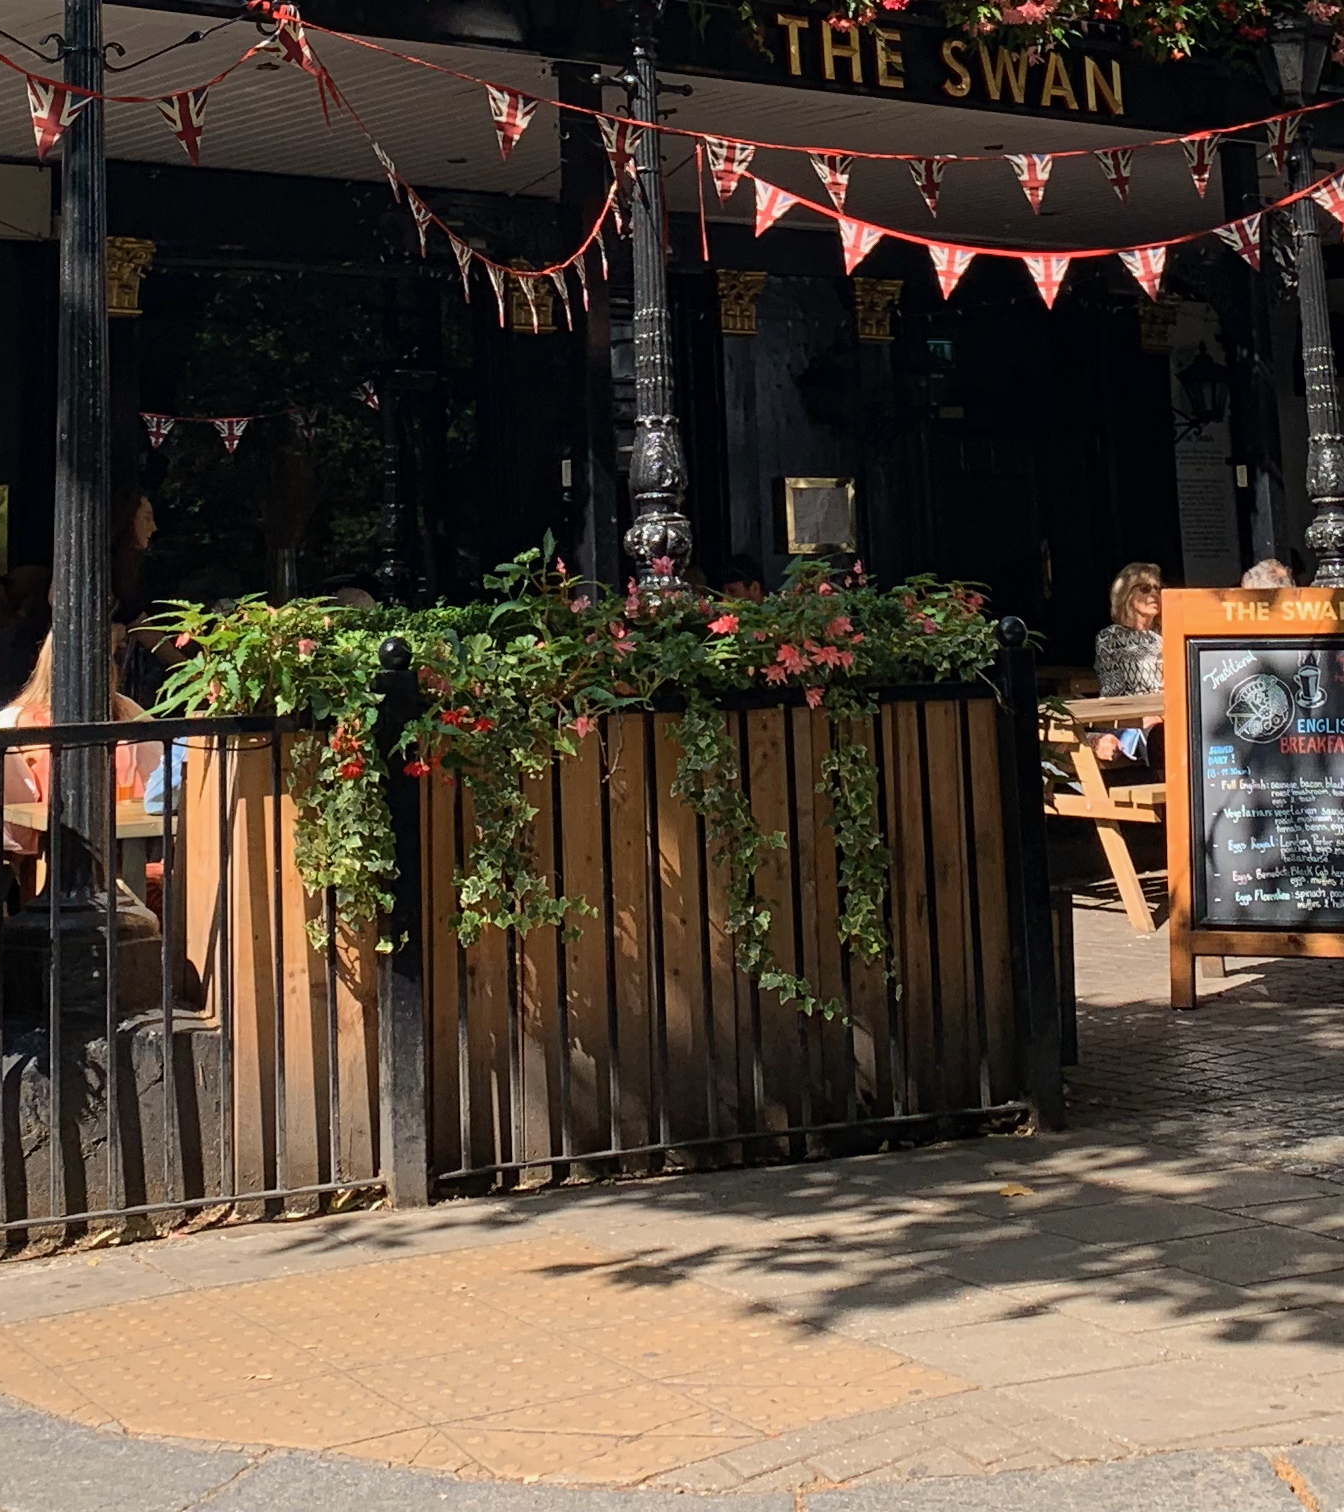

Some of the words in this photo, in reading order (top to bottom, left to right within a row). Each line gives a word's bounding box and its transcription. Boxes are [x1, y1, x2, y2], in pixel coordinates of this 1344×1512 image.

[777, 13, 905, 89] THE
[942, 37, 1124, 116] SWAN
[1222, 602, 1269, 621] THE
[1203, 651, 1258, 690] Traditional
[1221, 779, 1236, 790] Full
[1232, 870, 1253, 886] Eggs
[1235, 891, 1253, 906] Eggs
